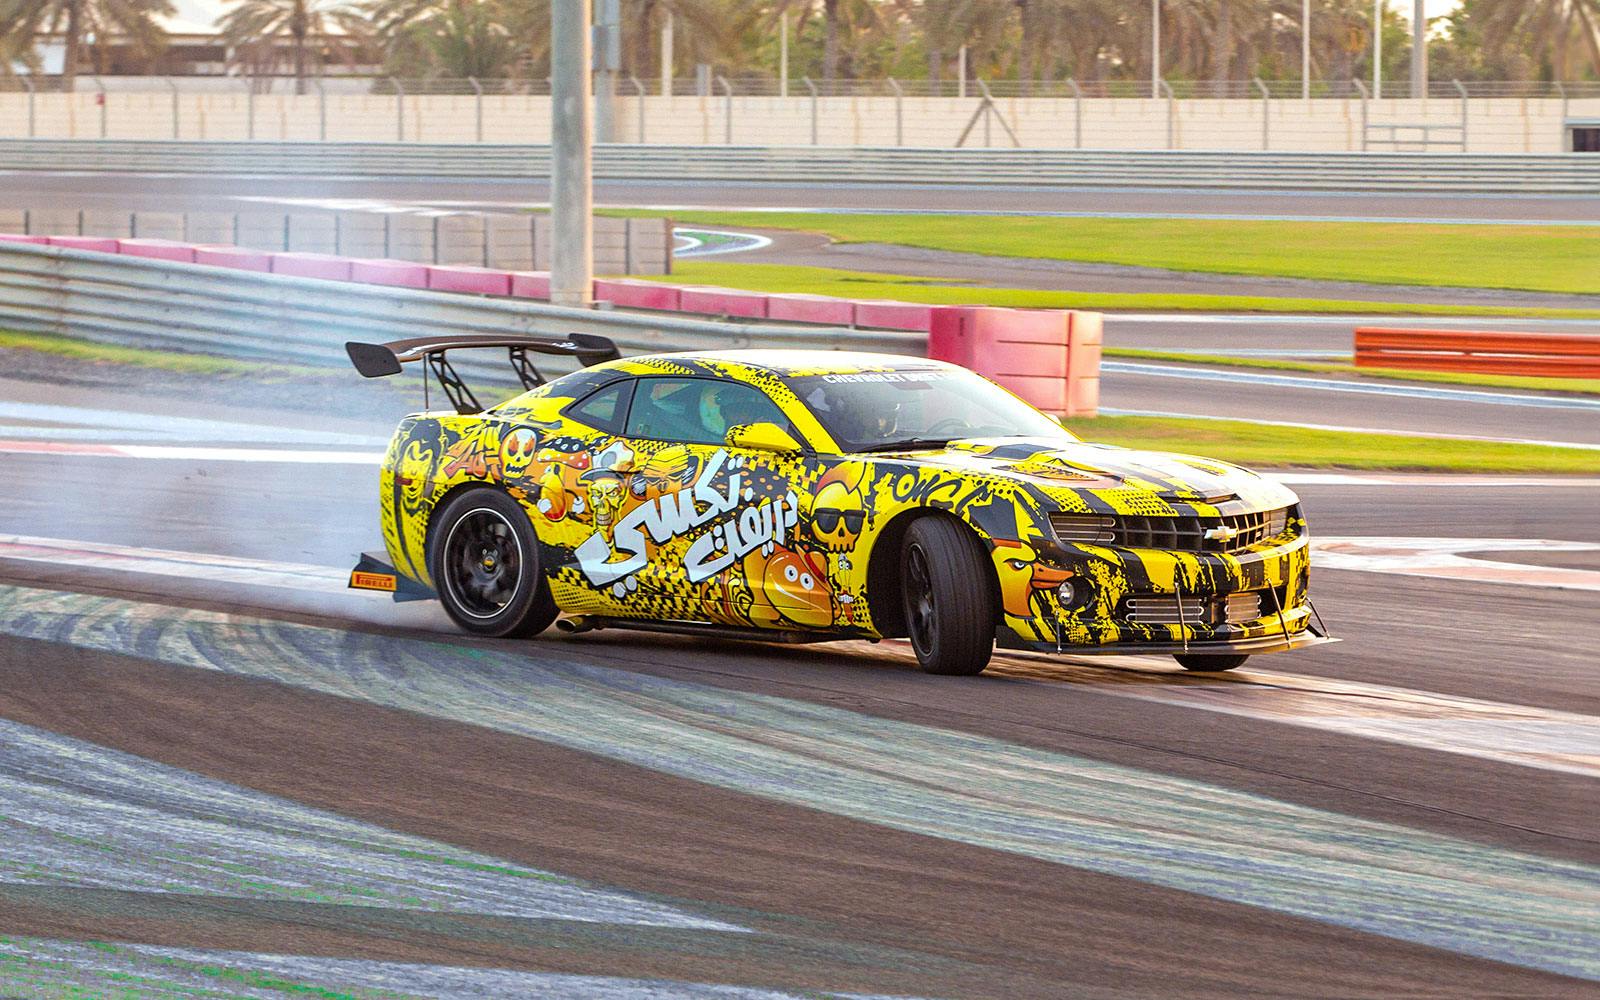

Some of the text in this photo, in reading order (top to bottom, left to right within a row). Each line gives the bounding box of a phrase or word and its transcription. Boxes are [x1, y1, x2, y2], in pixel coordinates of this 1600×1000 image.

[823, 373, 905, 384] CHEVROLET
[574, 448, 744, 599] تكسي
[355, 574, 393, 588] PIRELLI
